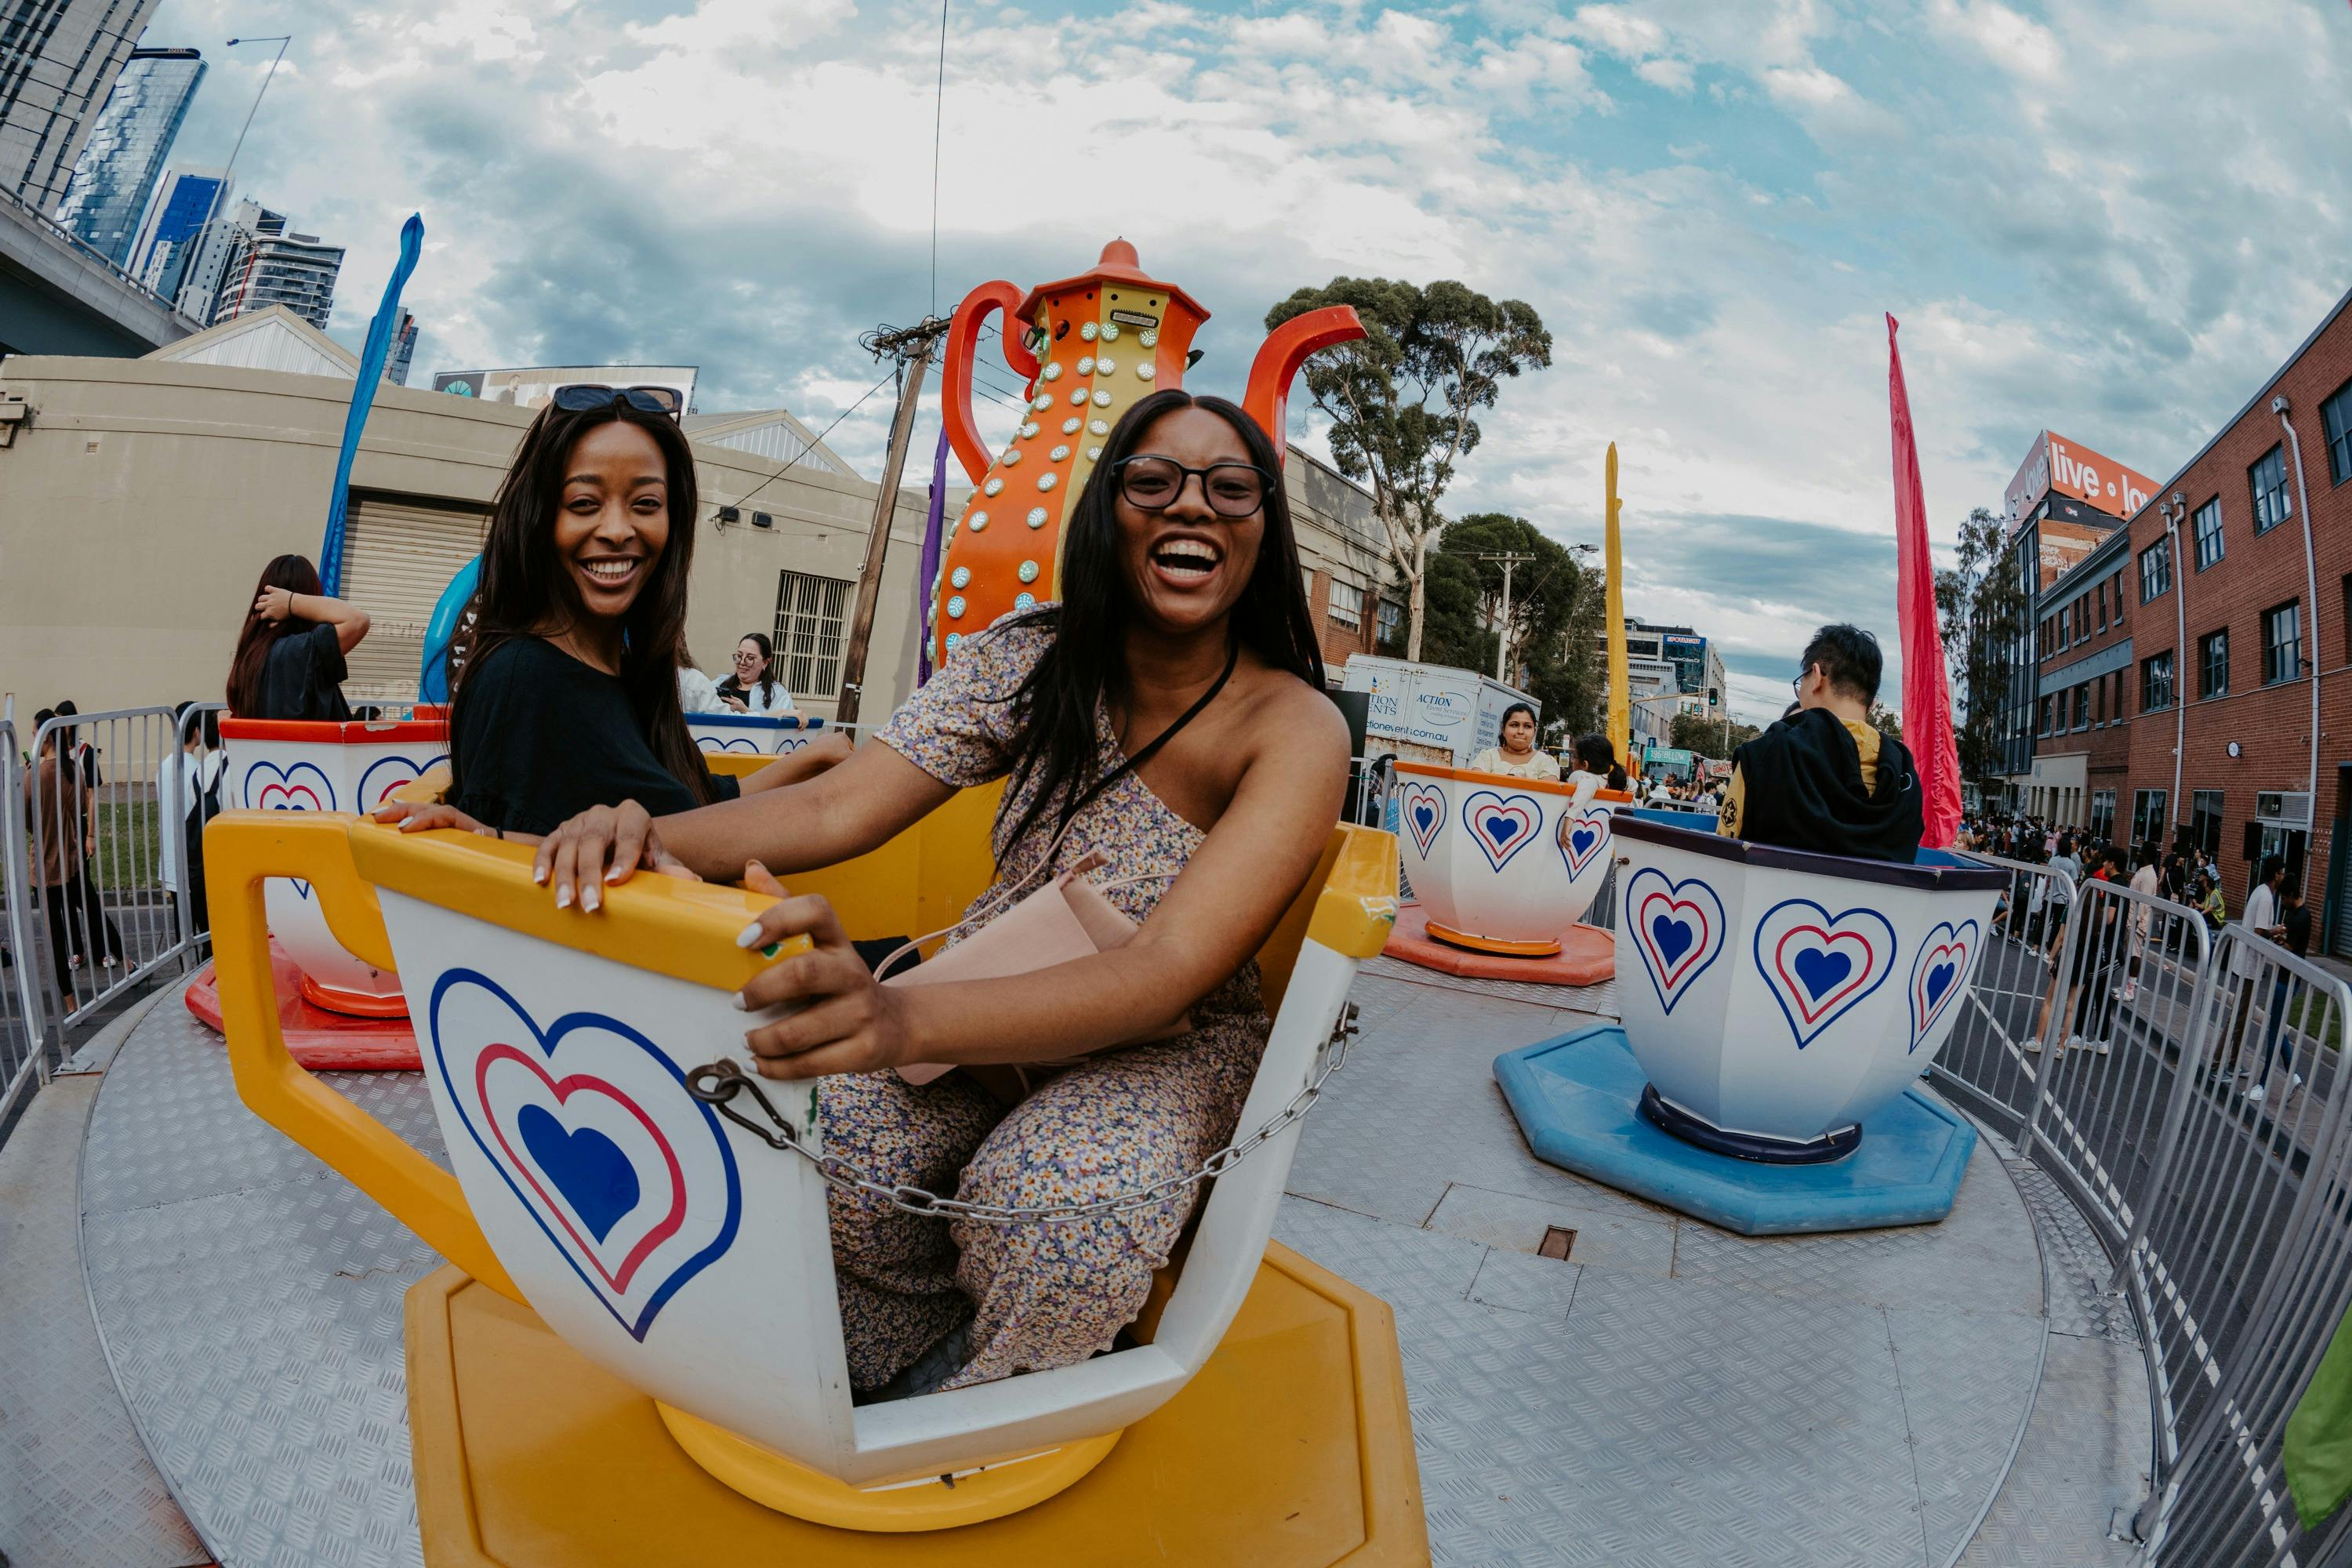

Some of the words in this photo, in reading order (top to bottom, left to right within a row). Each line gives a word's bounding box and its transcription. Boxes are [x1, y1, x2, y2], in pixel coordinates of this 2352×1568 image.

[2051, 441, 2100, 497] live
[1667, 636, 1701, 644] SPOTLIGHT
[1369, 694, 1398, 706] TION
[1417, 693, 1453, 707] ACTION
[1369, 704, 1396, 716] ENTS
